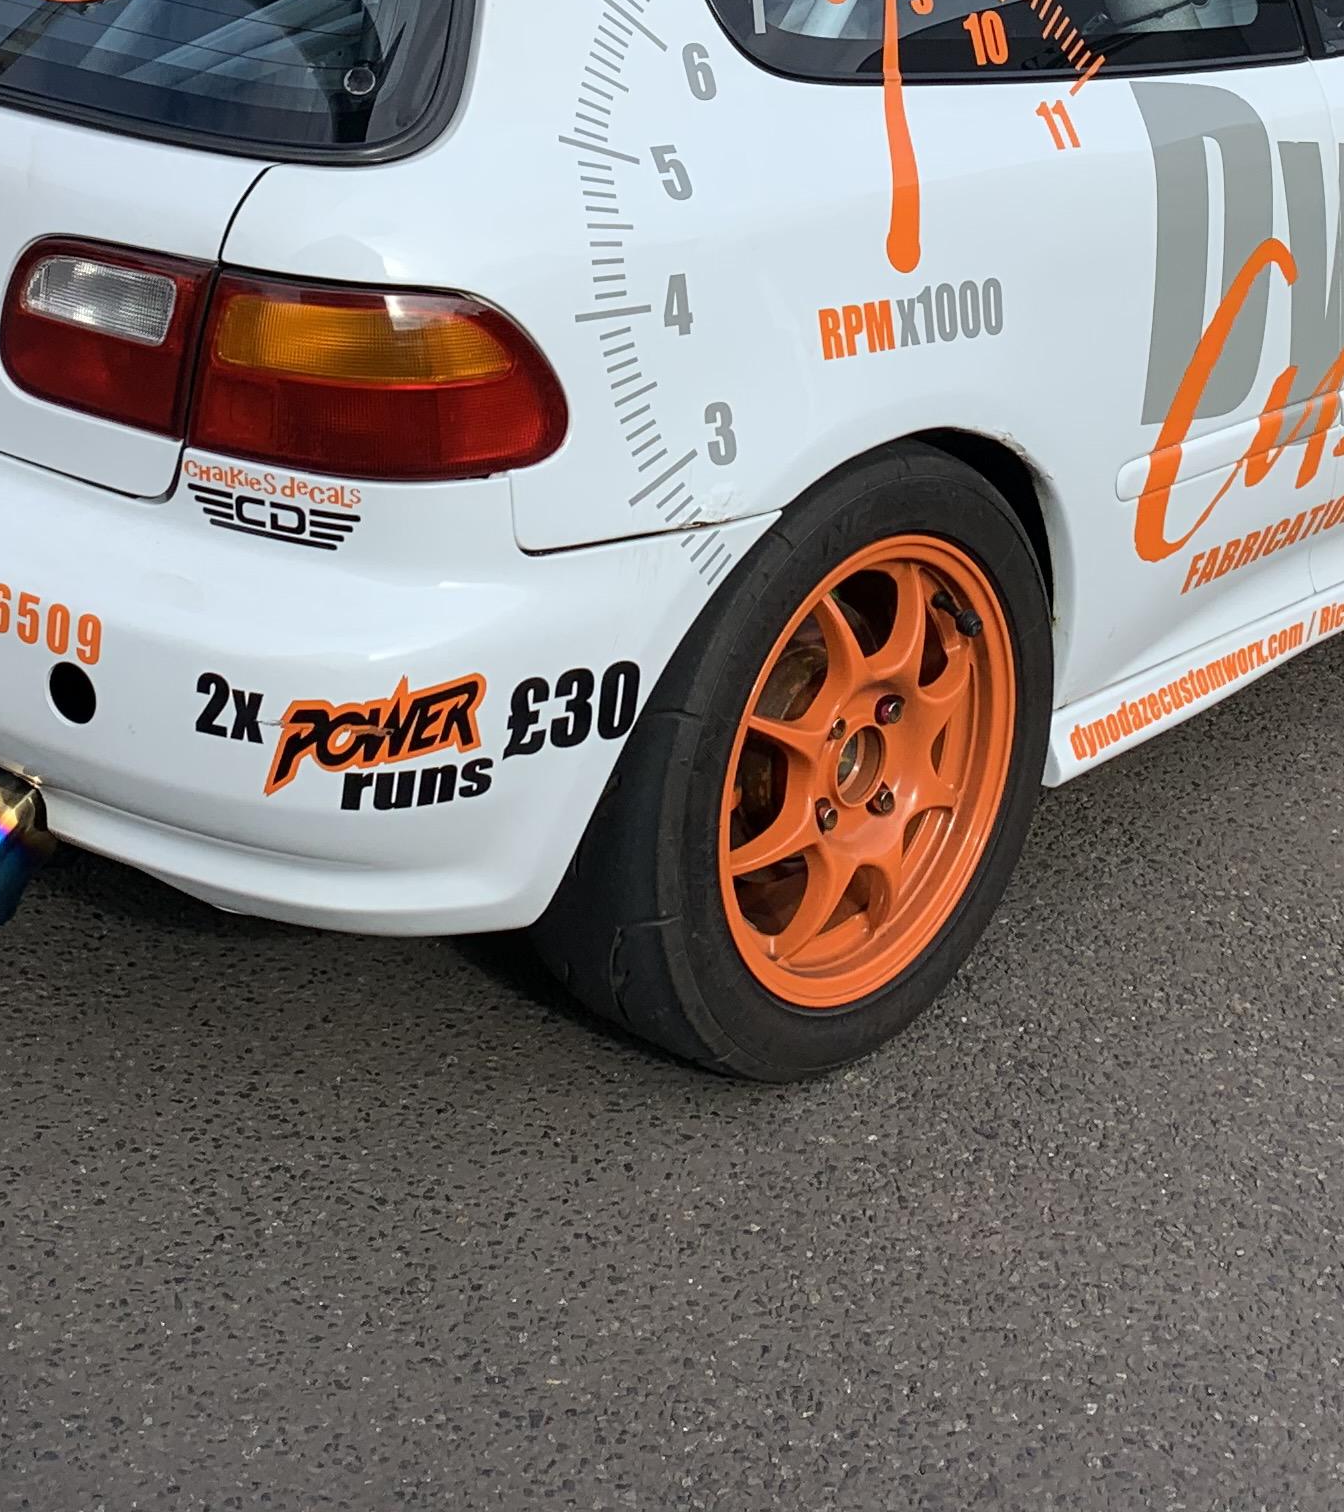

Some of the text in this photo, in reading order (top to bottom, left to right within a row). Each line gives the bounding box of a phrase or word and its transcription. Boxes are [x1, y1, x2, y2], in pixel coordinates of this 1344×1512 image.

[962, 11, 1009, 65] 10
[682, 42, 717, 100] 6
[1035, 99, 1080, 150] 11
[650, 144, 693, 200] 5
[664, 273, 693, 335] 4
[704, 402, 737, 466] 3
[235, 495, 306, 535] CD
[1069, 621, 1304, 761] dynodazecustomworx.com
[195, 661, 641, 793] 2x POWER £30
[341, 758, 494, 811] runs
